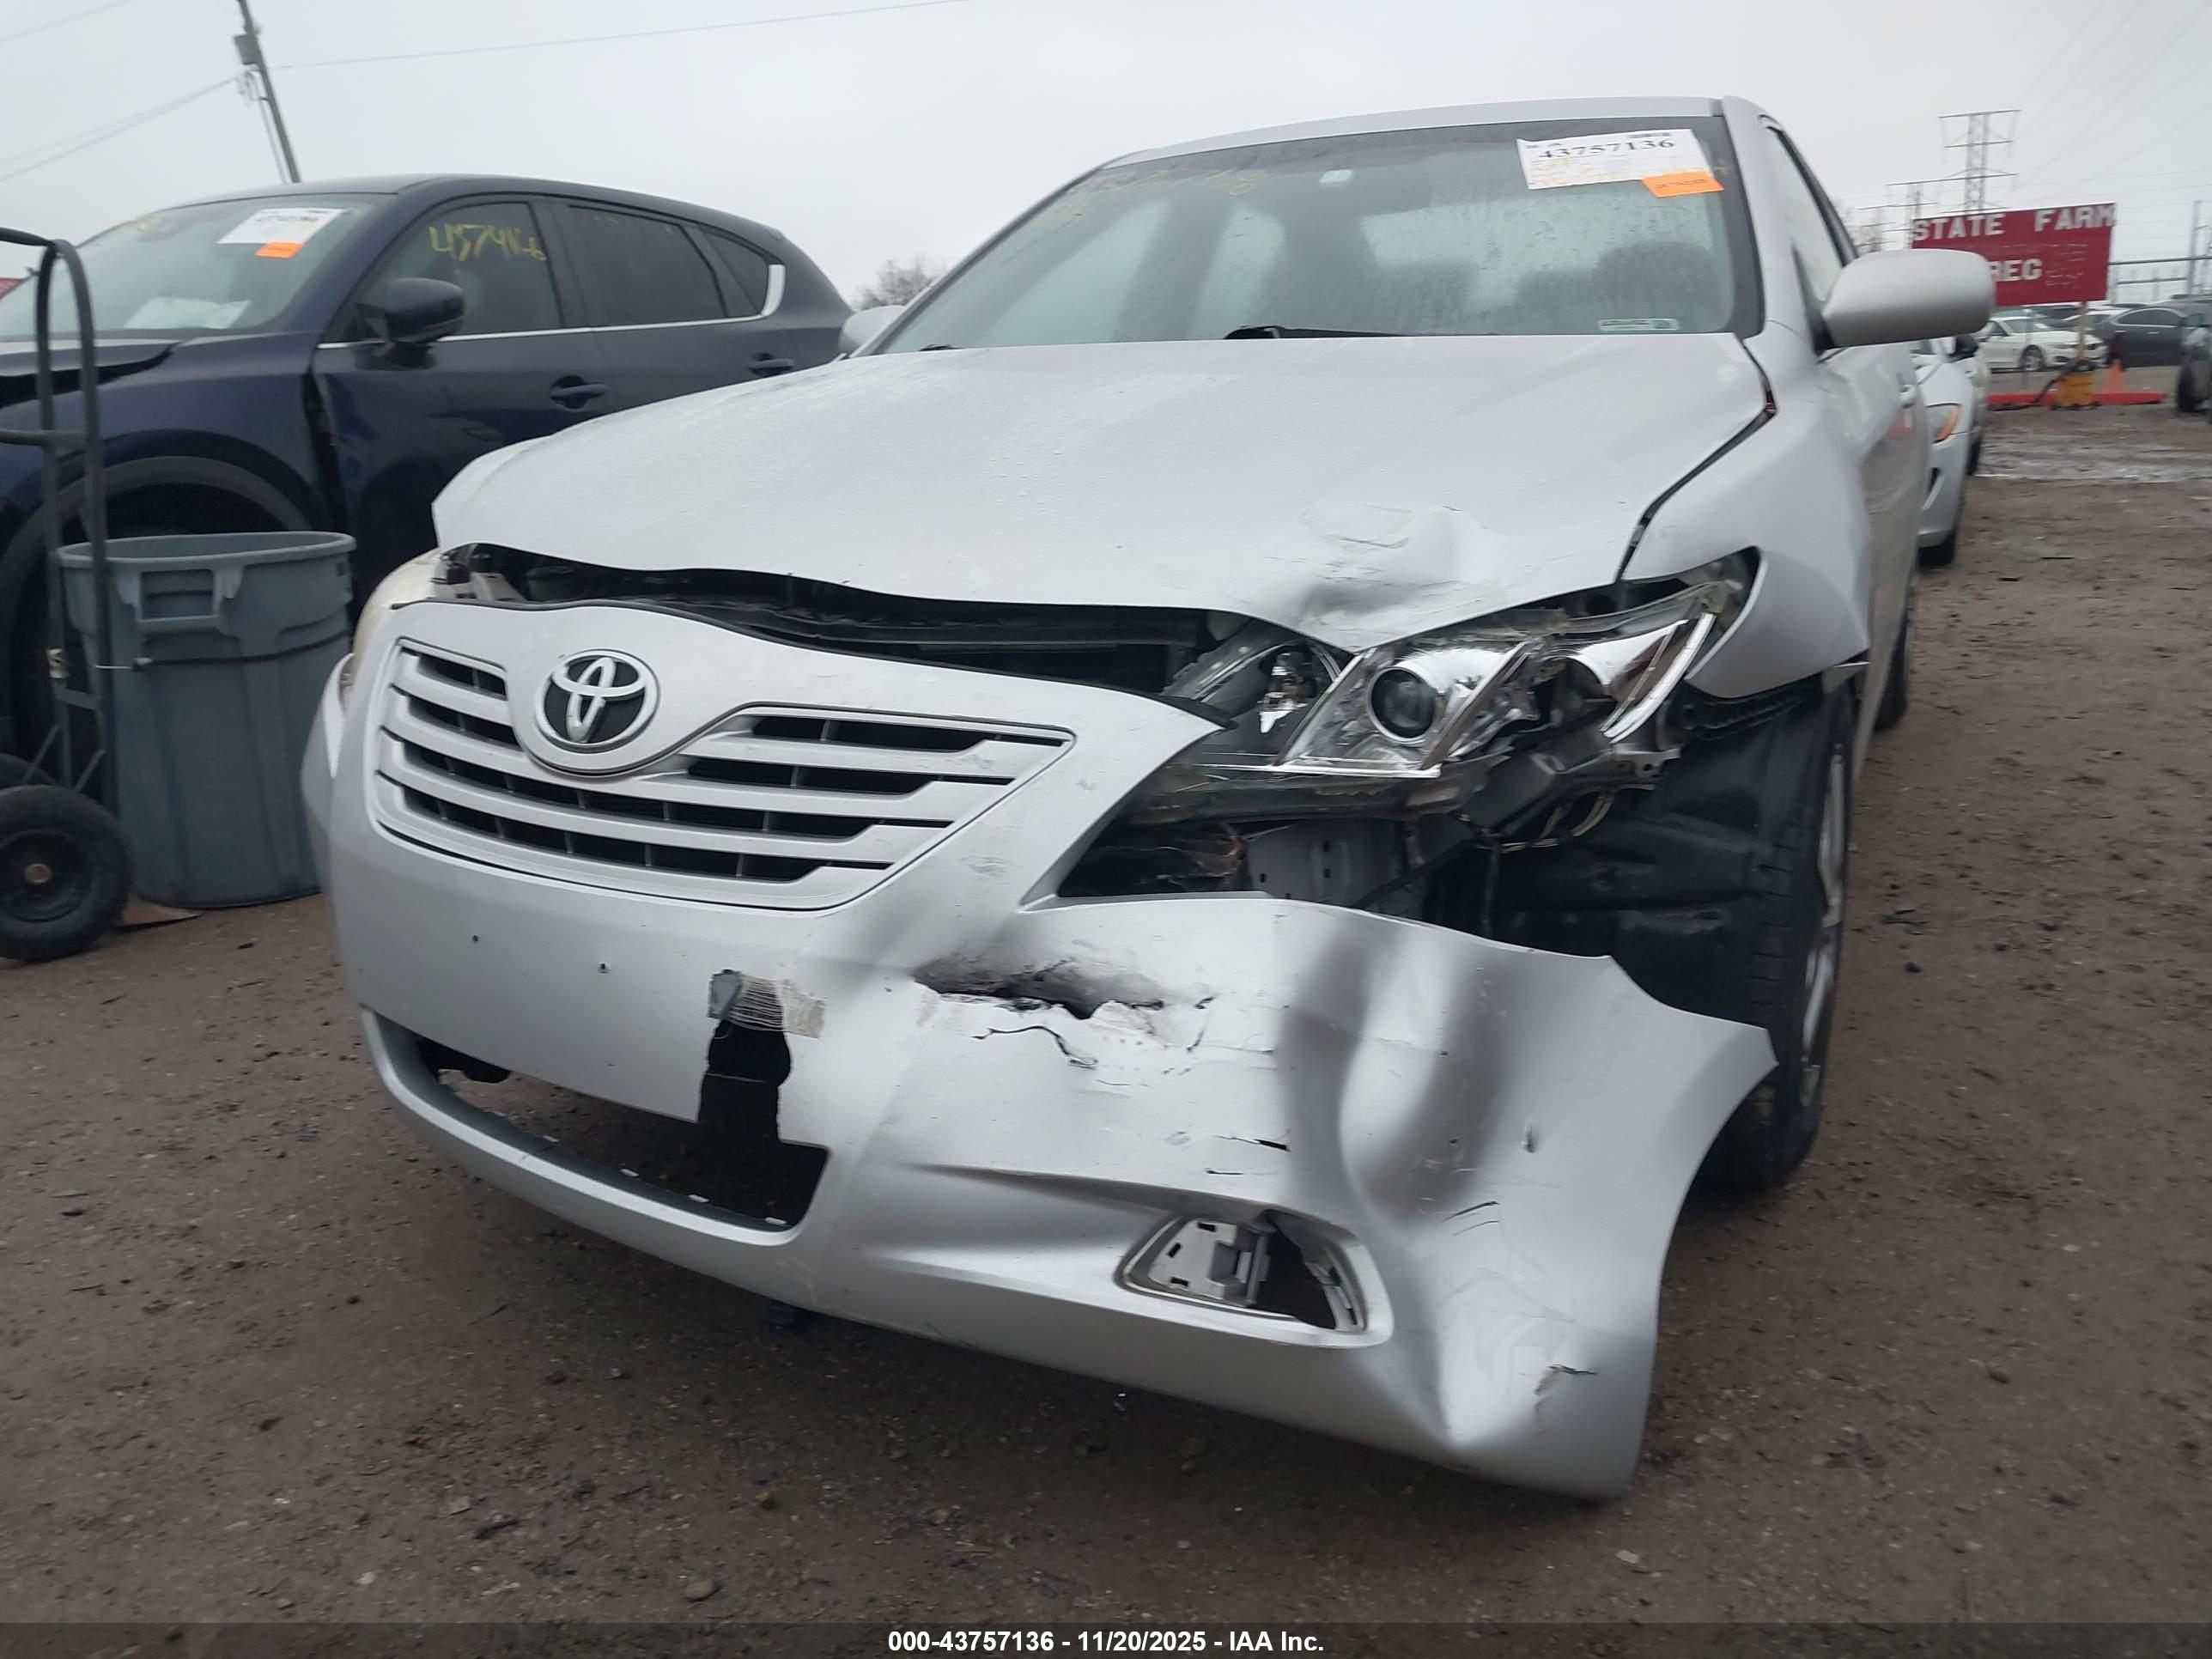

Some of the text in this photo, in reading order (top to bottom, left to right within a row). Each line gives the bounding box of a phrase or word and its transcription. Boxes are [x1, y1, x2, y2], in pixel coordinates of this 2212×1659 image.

[1538, 139, 1674, 158] 43757136
[1912, 205, 2115, 241] STATE FARM
